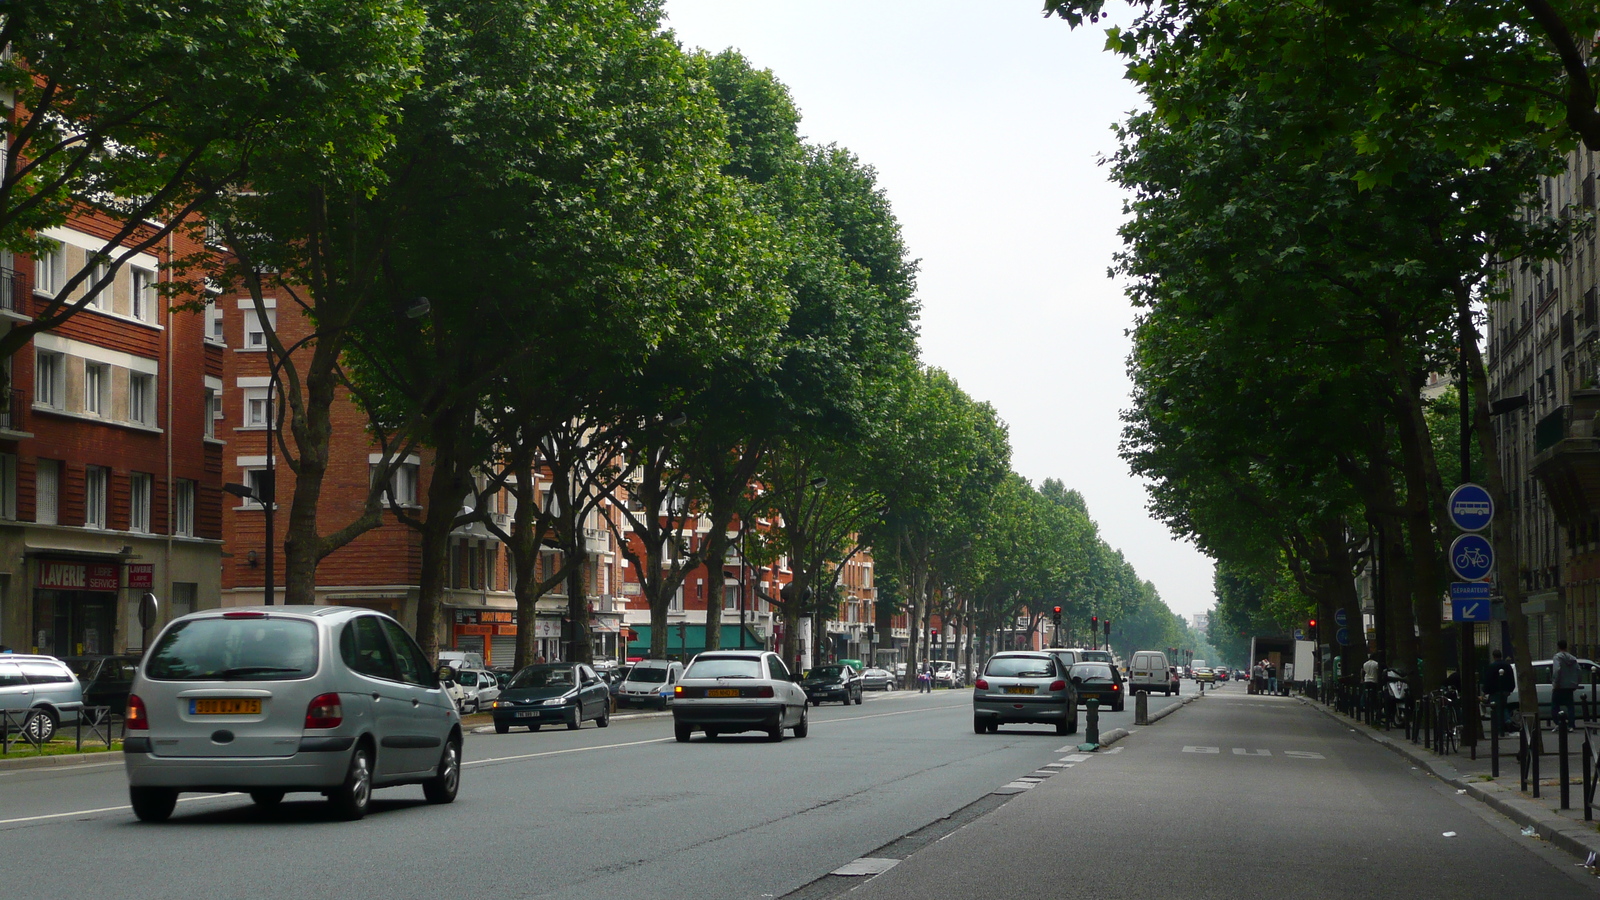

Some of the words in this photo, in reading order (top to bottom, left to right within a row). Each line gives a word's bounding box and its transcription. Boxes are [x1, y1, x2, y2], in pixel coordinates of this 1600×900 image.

[94, 566, 113, 577] LIBRE
[130, 564, 152, 573] LAVERIE
[41, 563, 86, 587] LAVERIE
[90, 579, 118, 589] SERVICE
[1452, 585, 1488, 594] SÉPARATEUR
[244, 700, 258, 713] 75
[1182, 745, 1327, 760] BUS
